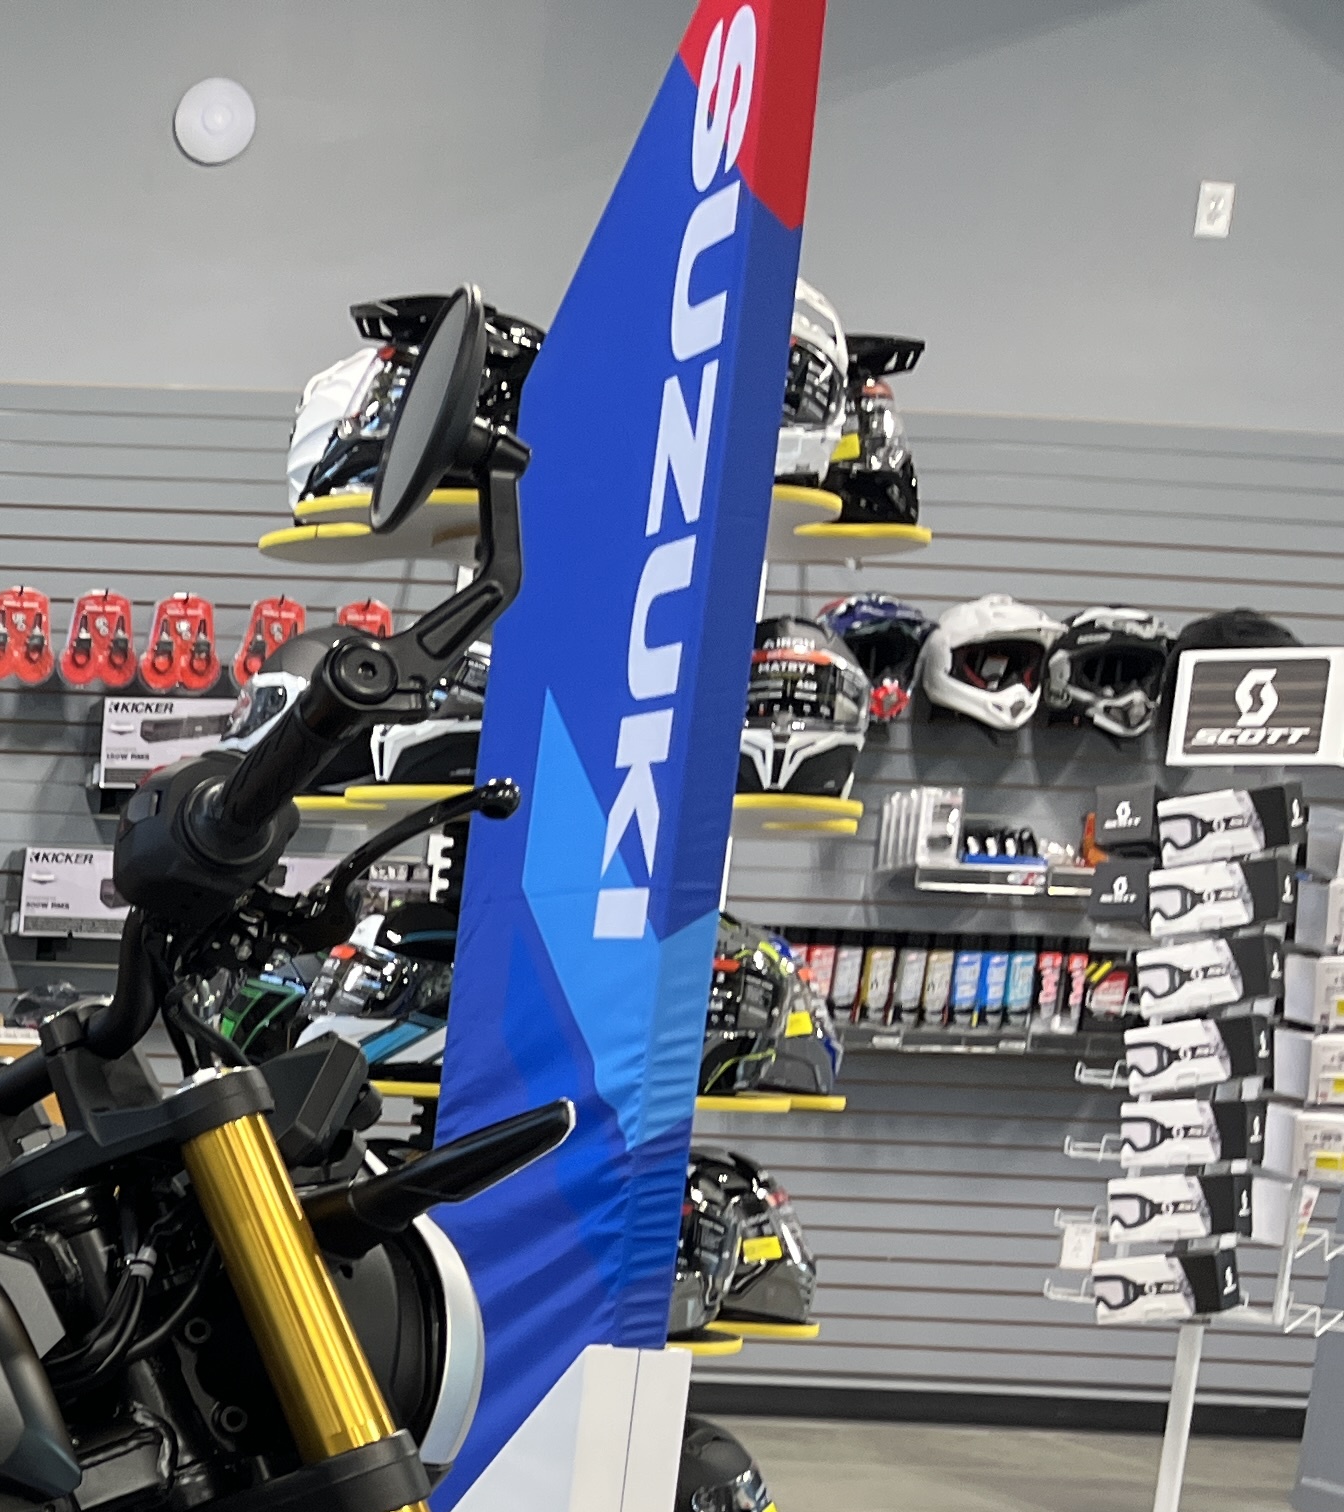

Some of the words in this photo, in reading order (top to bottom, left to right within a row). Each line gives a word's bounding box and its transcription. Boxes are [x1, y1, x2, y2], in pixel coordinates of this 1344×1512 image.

[593, 4, 758, 940] SUZUKI
[120, 701, 174, 714] KICKER
[1191, 726, 1311, 746] SCOTT
[41, 851, 94, 865] KICKER
